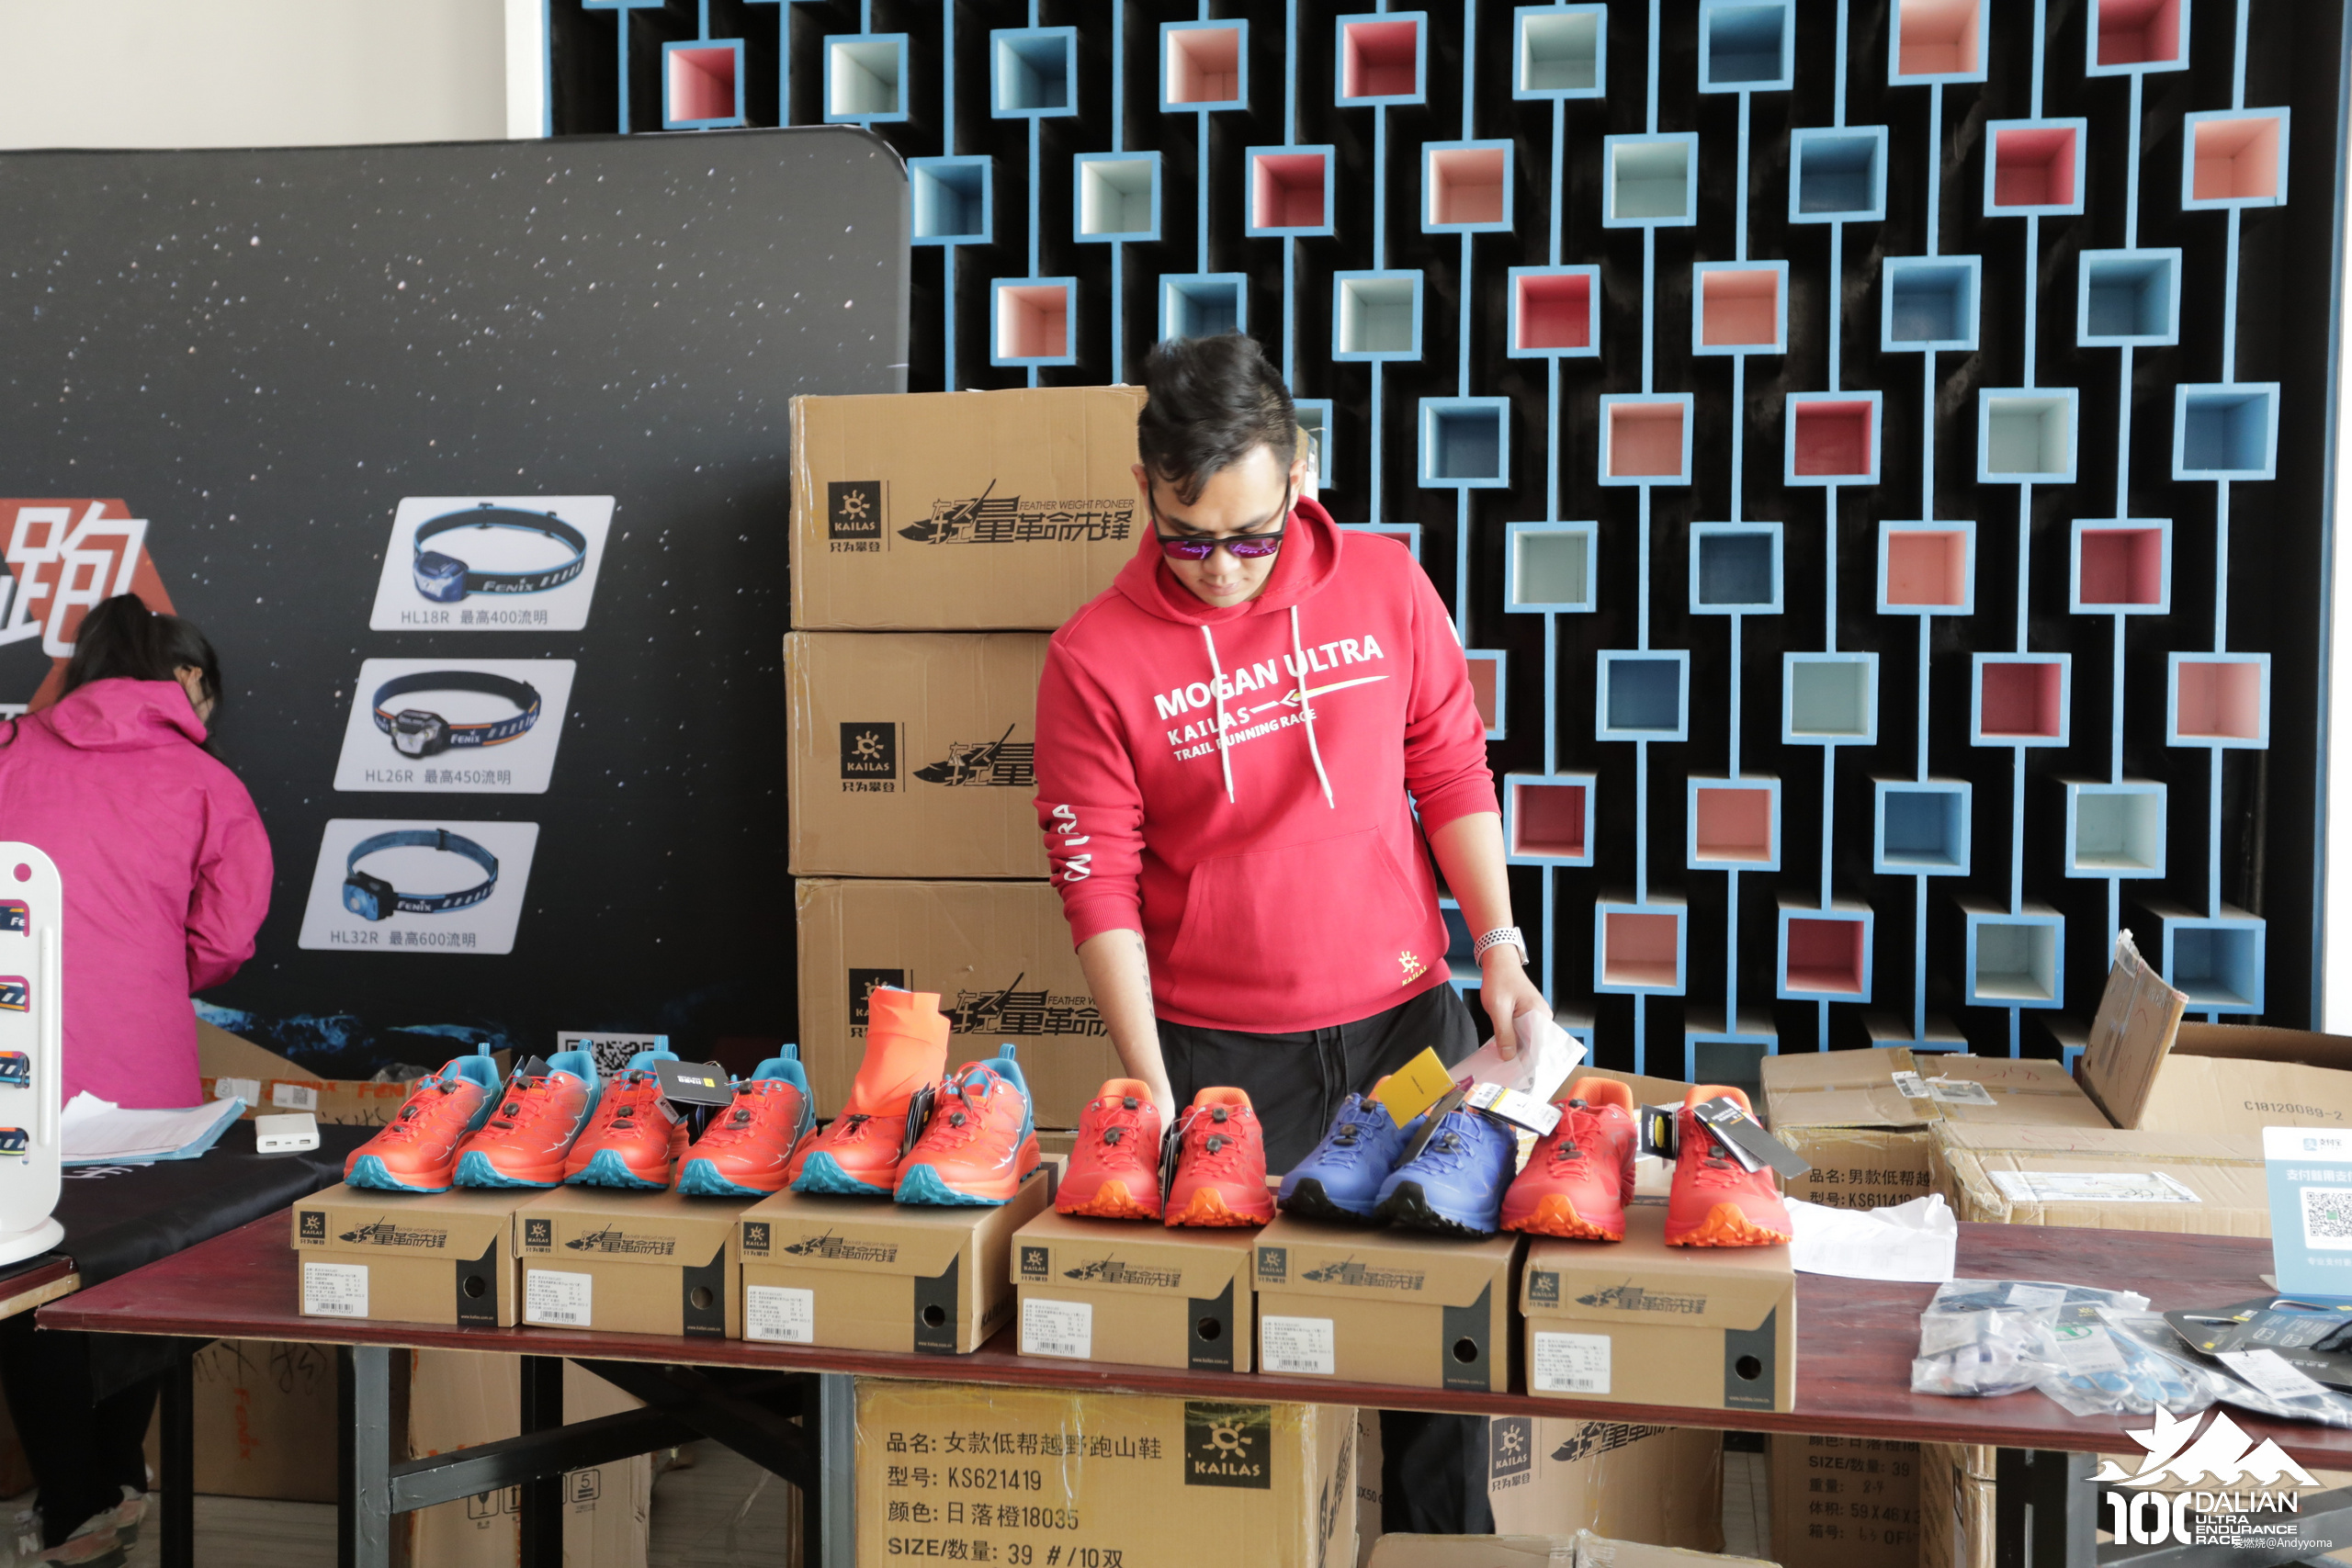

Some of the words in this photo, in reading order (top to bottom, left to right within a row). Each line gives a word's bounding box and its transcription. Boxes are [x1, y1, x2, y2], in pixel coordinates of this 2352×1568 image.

[1020, 502, 1057, 510] FEATHER
[1095, 500, 1135, 509] PIONEER
[834, 522, 876, 531] KAILAS
[830, 542, 880, 552] 只为攀登
[401, 611, 449, 624] HL18R
[460, 610, 548, 626] 最高400流明
[1154, 659, 1279, 720] MOGAN
[1283, 634, 1385, 678] ULTRA
[1167, 706, 1250, 746] KAILAS
[1174, 742, 1215, 761] TRAIL
[1281, 708, 1317, 728] RACE
[847, 762, 889, 772] KAILAS
[366, 770, 413, 783] HL26R
[424, 770, 512, 784] 最高450流明
[842, 782, 895, 793] 只为攀登
[330, 931, 379, 944] HL32R
[389, 931, 477, 948] 最高600流明
[1402, 964, 1428, 987] KAILAS
[1047, 996, 1087, 1006] FEATHER
[2244, 1100, 2344, 1121] C18120089-2
[1809, 1168, 1845, 1184] 品名:
[1849, 1168, 1930, 1188] 男款低帮越
[887, 1432, 937, 1454] 品名:
[944, 1431, 1163, 1461] 女款低帮越野跑山鞋
[1194, 1461, 1260, 1476] KAILAS
[1496, 1454, 1528, 1470] KAILAS
[888, 1465, 937, 1488] 型号:
[948, 1467, 1042, 1491] KS621419
[888, 1500, 938, 1523] 颜色:
[948, 1502, 1079, 1529] 日落橙18035
[888, 1537, 998, 1562] SIZE/数量:
[1008, 1543, 1033, 1565] 39
